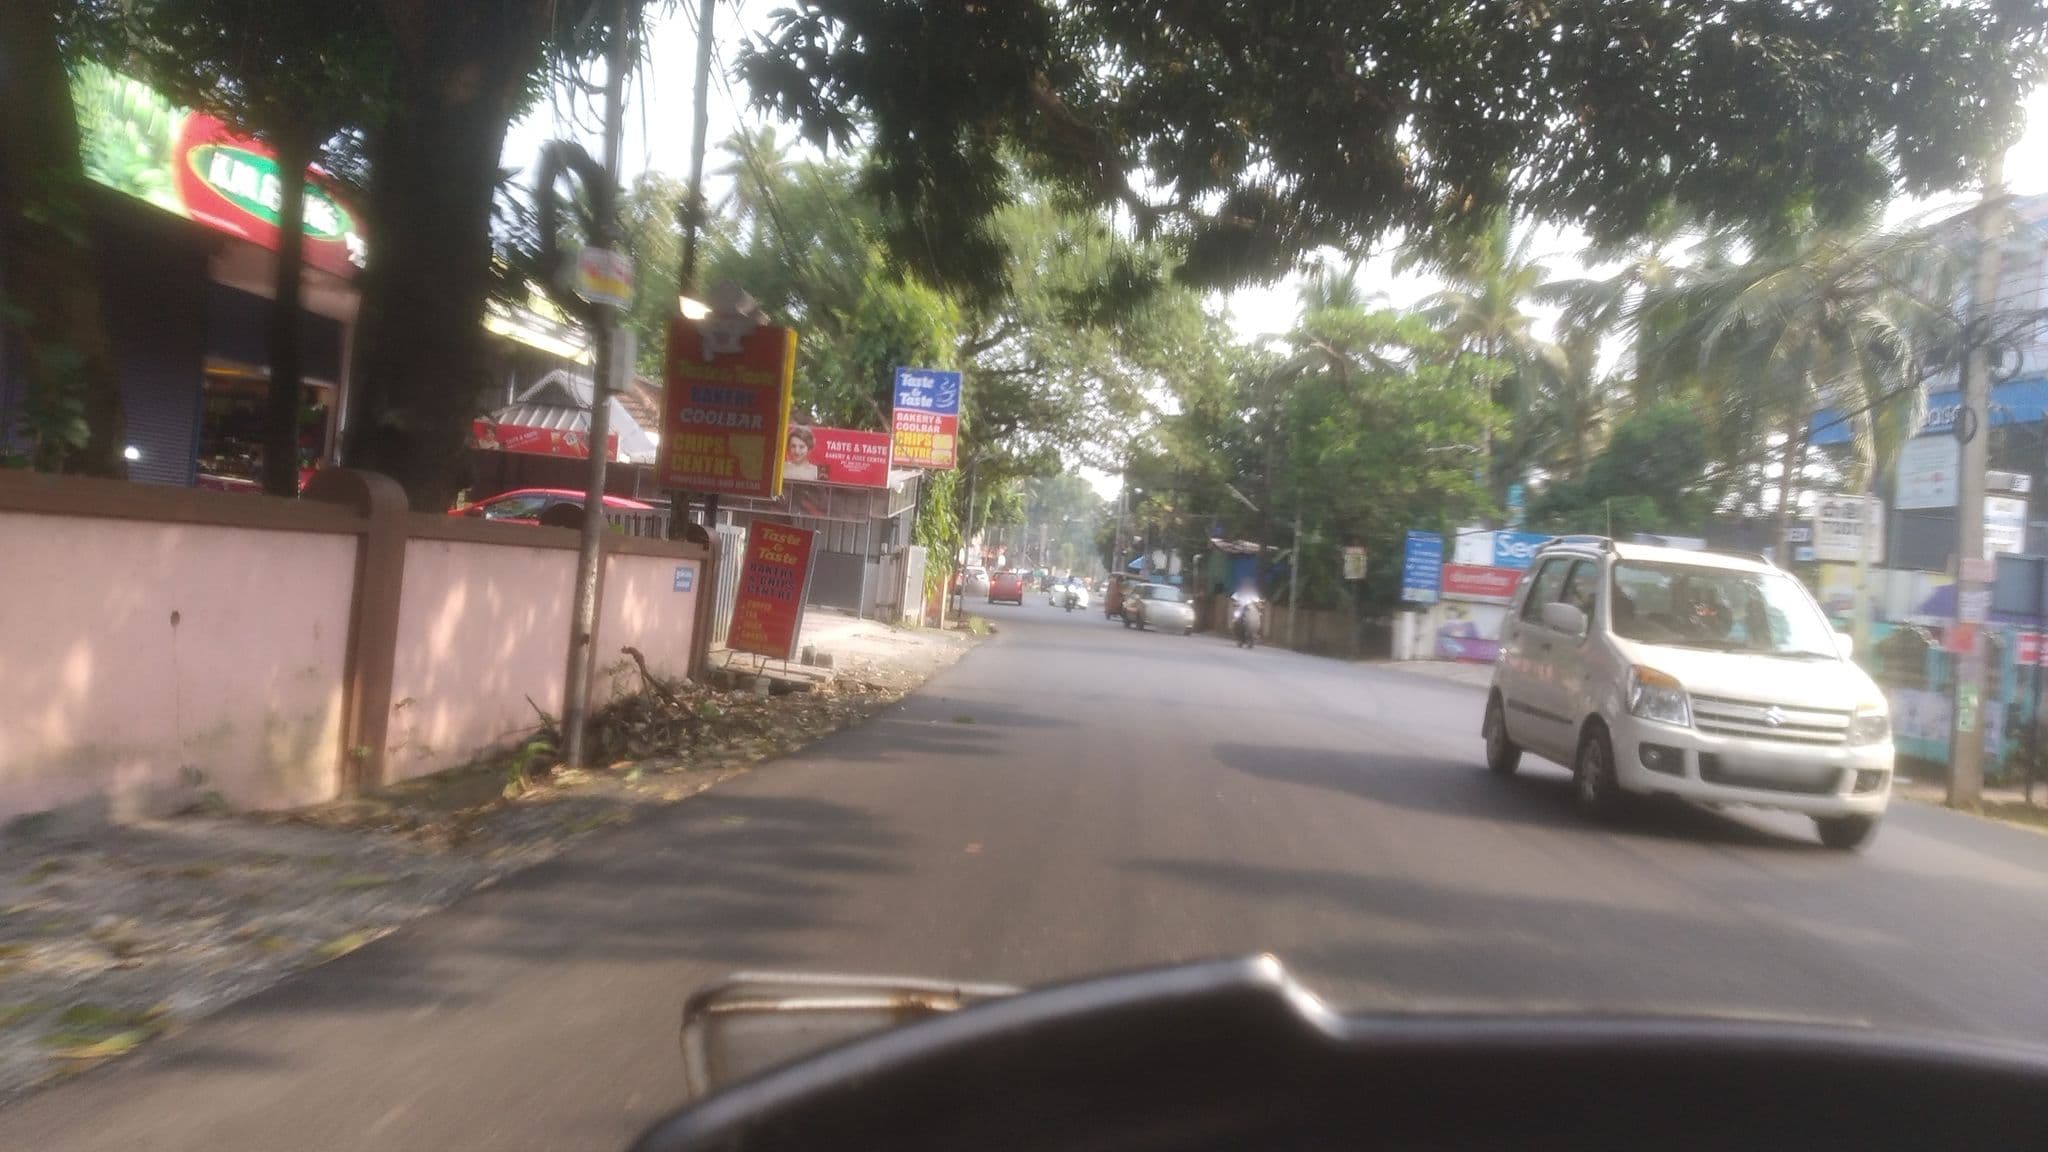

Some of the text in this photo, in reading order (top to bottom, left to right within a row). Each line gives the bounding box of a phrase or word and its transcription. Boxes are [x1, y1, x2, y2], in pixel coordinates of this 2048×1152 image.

[899, 372, 936, 389] Taste
[899, 392, 934, 408] Taste
[681, 408, 762, 429] COOLBAR
[896, 412, 934, 424] BAKERY
[896, 422, 941, 433] COOLBAR
[673, 432, 723, 453] CHIPS
[896, 432, 932, 446] CHIPS
[826, 440, 889, 456] TASTE & TASTE
[895, 446, 931, 458] CENTRE
[673, 454, 737, 476] CENTRE
[761, 528, 801, 546] Taste
[759, 547, 798, 565] Taste
[746, 583, 793, 602] CENTRE
